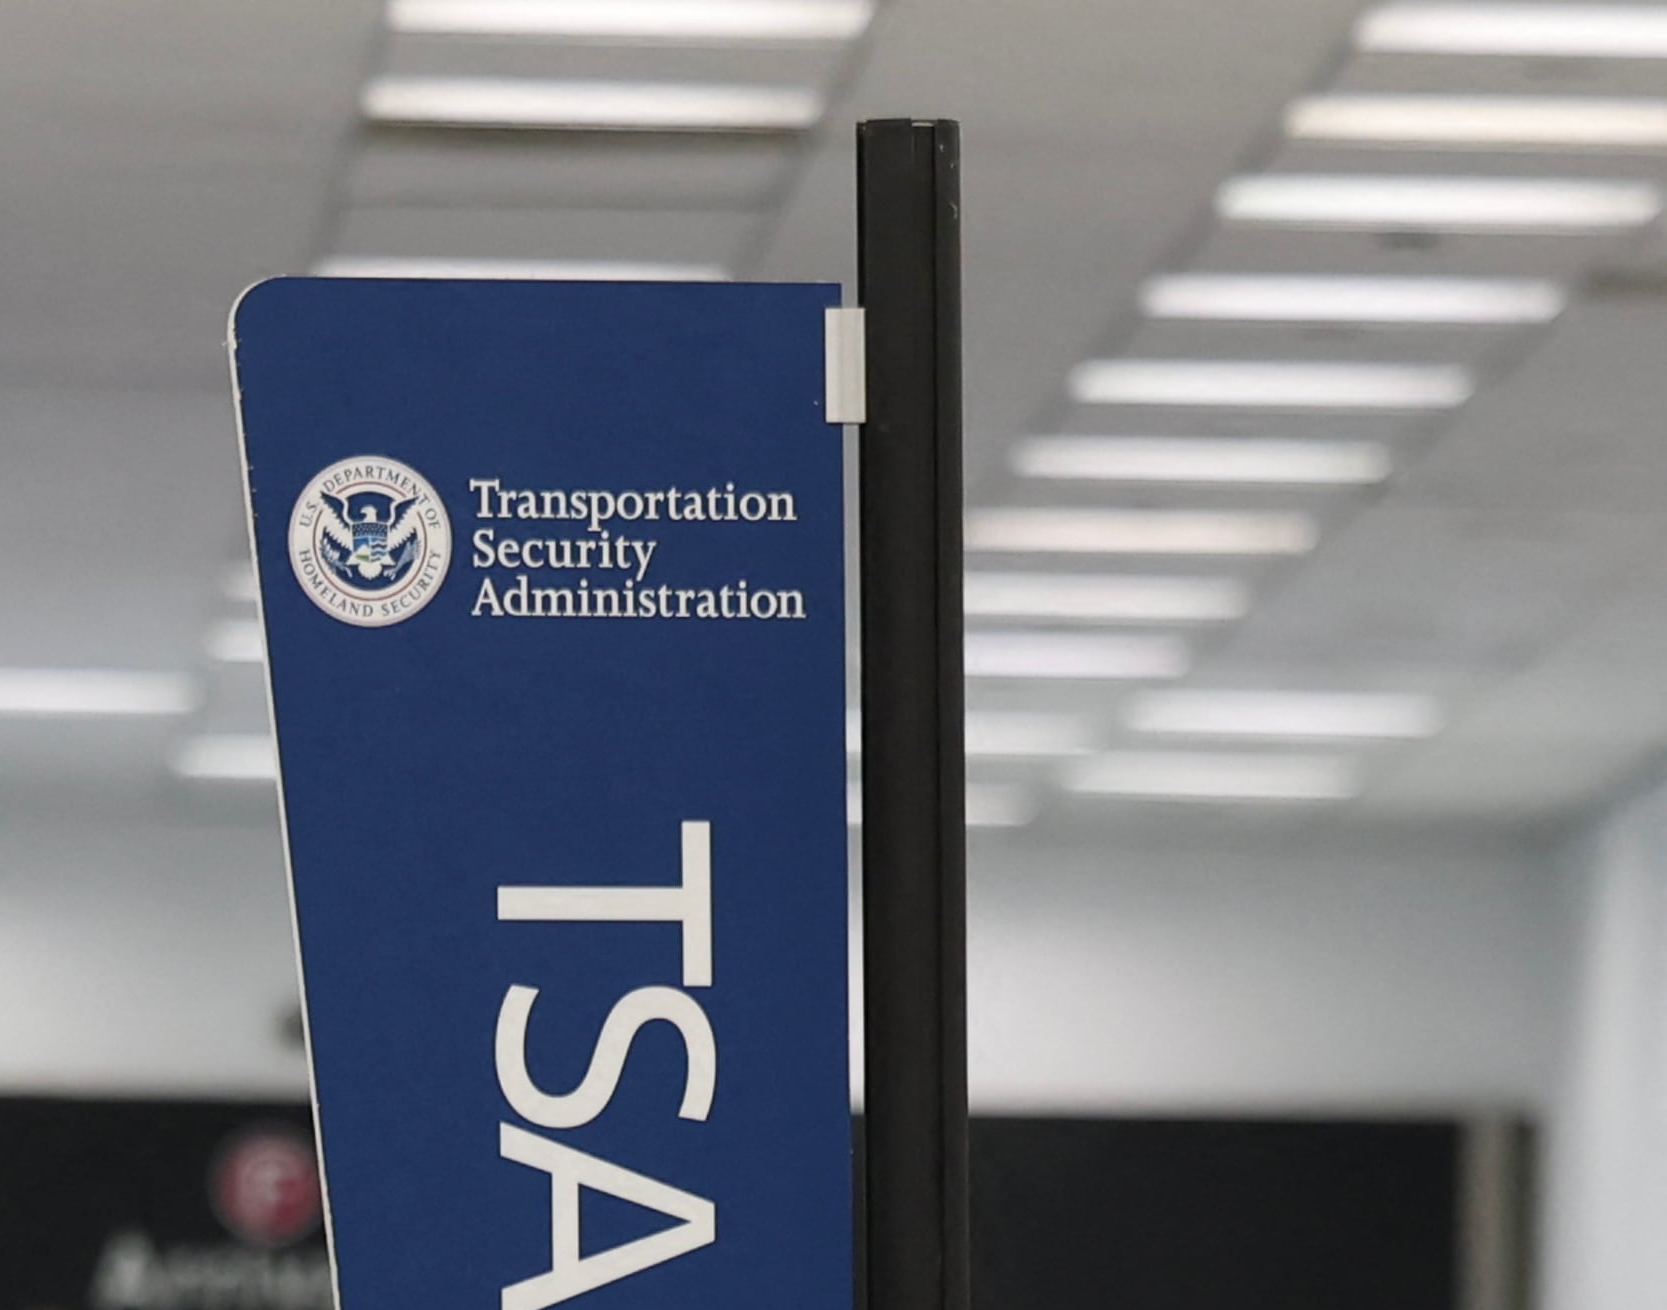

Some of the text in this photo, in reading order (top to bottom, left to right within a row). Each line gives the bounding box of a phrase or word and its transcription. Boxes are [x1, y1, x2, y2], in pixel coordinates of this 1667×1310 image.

[323, 465, 429, 505] DEPARTMENT
[424, 508, 441, 530] OF
[470, 479, 798, 531] Transportation
[472, 529, 657, 581] Security
[299, 549, 442, 618] HOMELAND SECURITY
[471, 575, 807, 620] Administration
